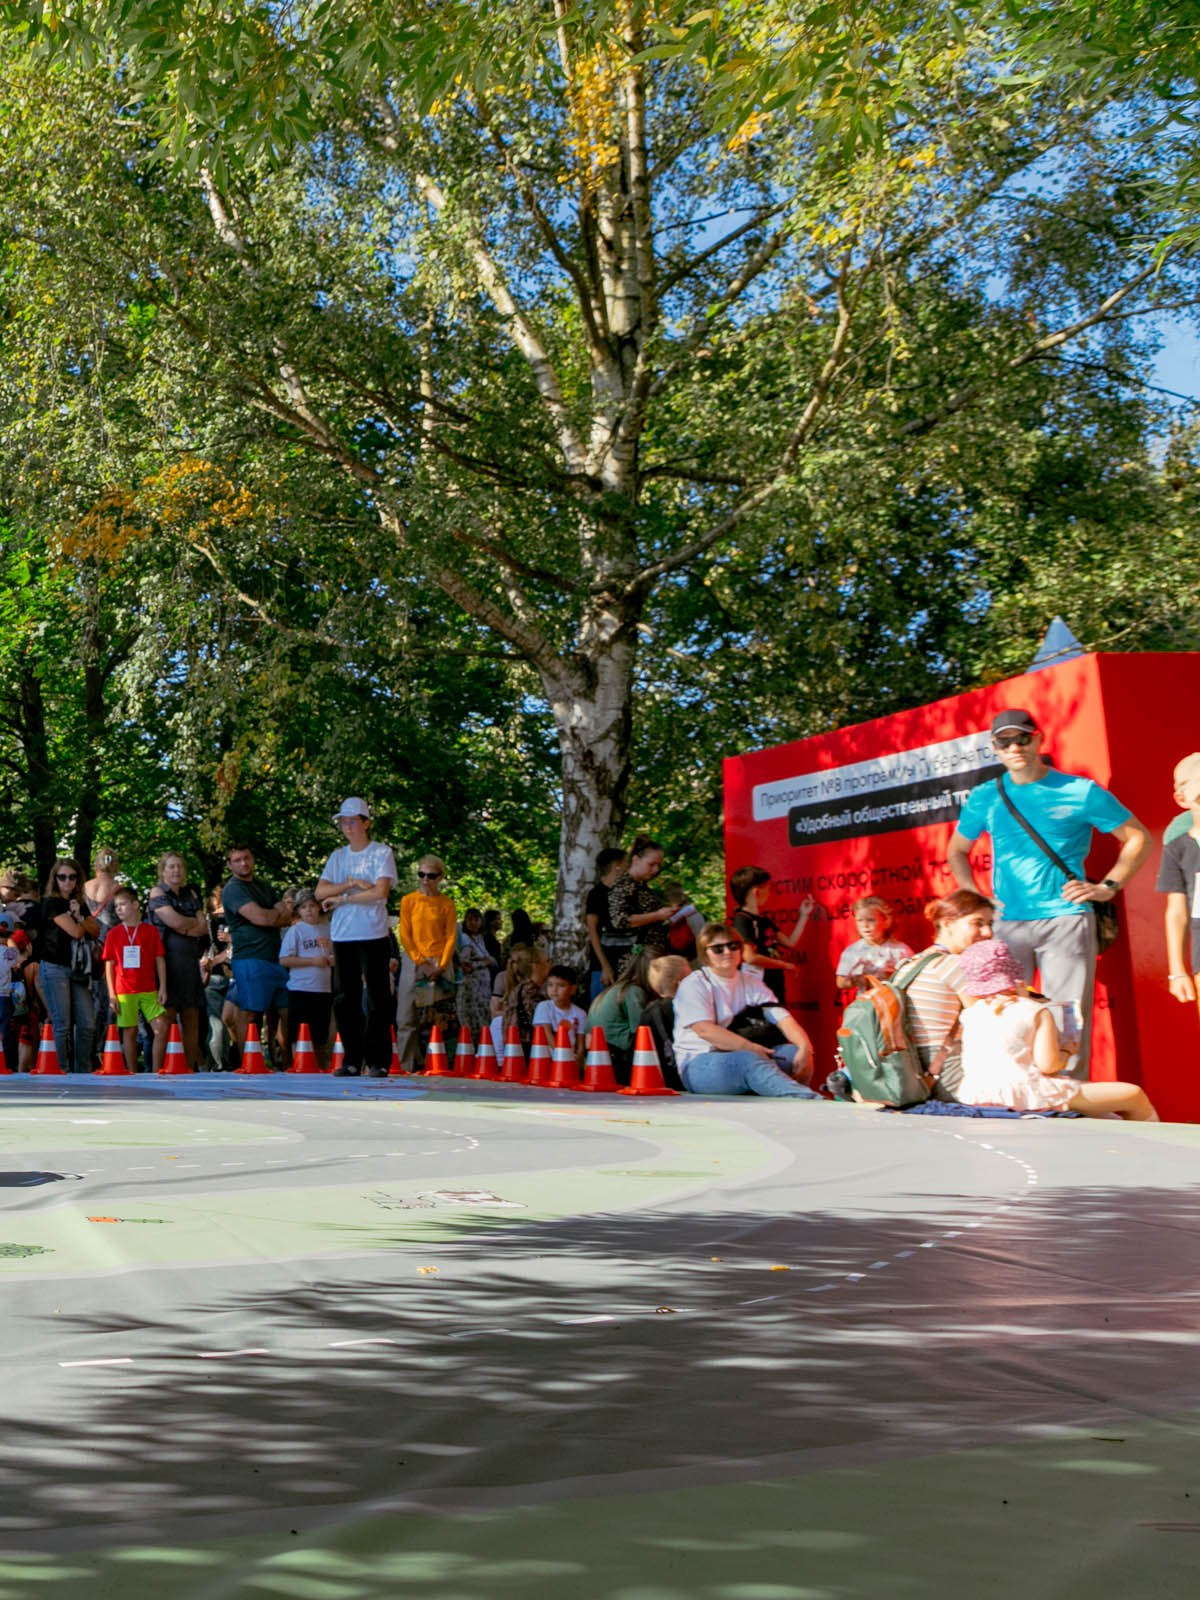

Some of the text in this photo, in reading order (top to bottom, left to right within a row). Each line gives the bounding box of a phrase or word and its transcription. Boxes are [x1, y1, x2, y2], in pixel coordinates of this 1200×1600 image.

[761, 785, 818, 808] Приоритет
[821, 777, 841, 795] №8
[844, 763, 916, 793] программы
[796, 808, 852, 834] «Удобный
[853, 790, 952, 824] общественный
